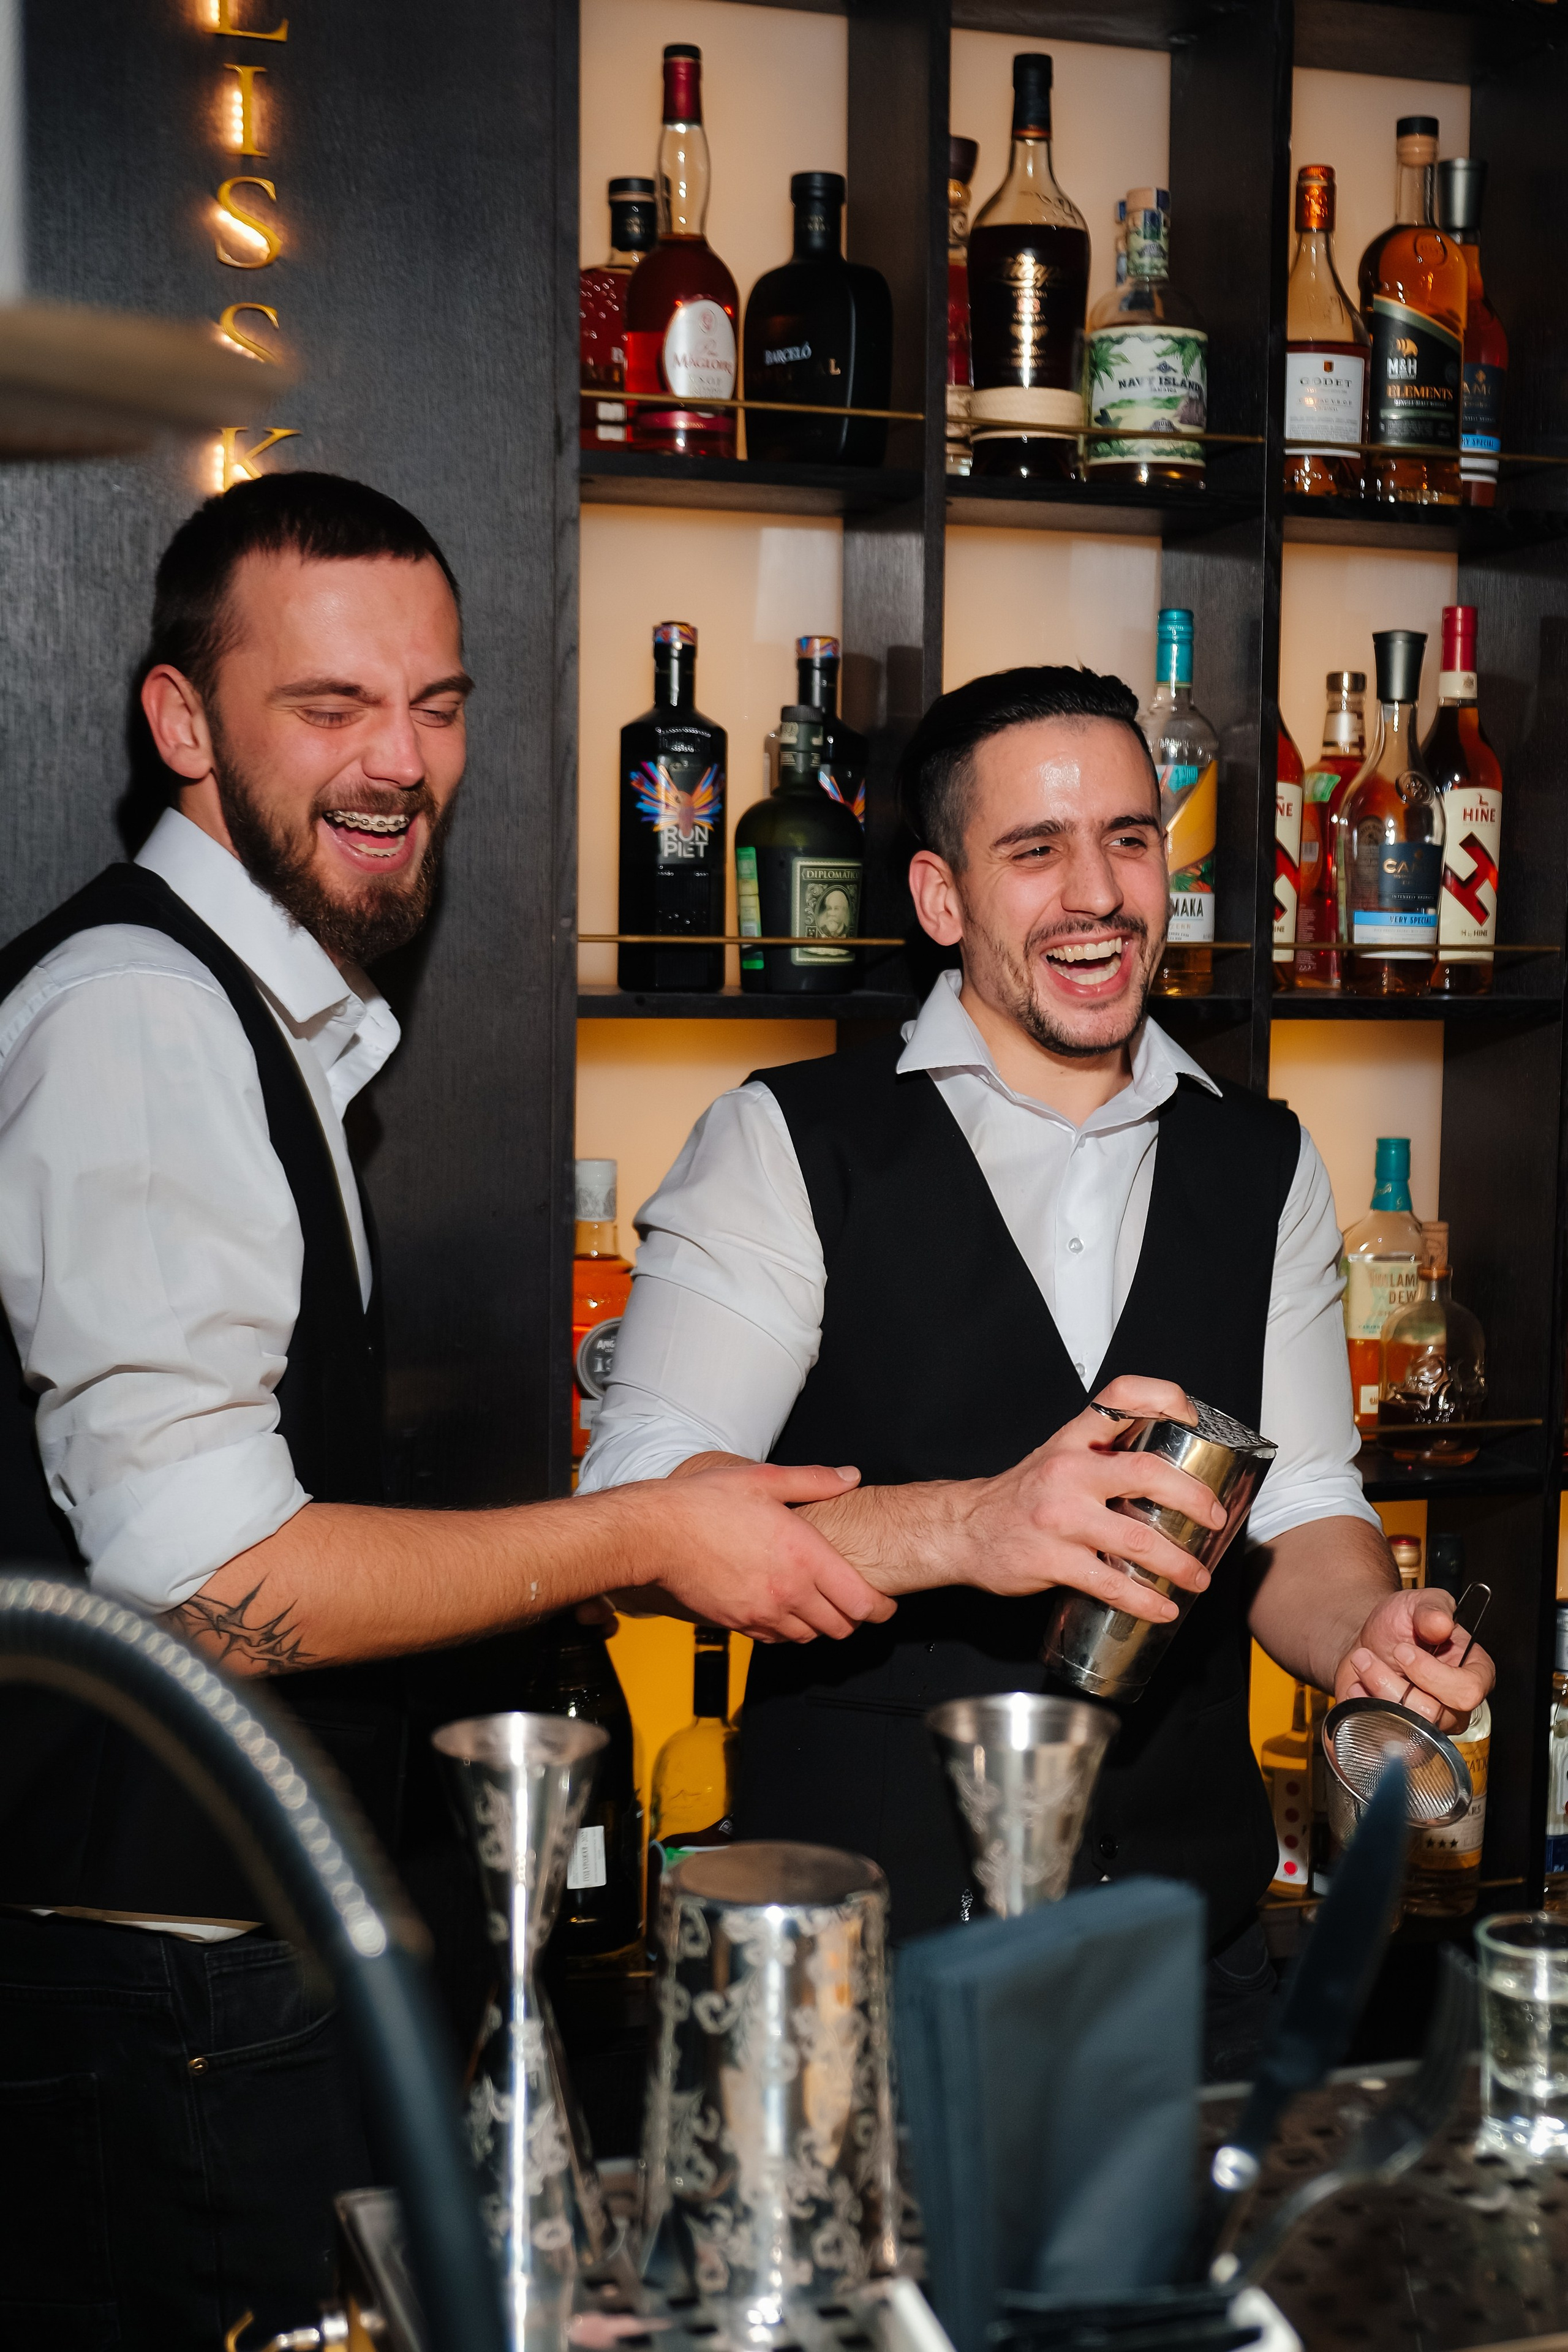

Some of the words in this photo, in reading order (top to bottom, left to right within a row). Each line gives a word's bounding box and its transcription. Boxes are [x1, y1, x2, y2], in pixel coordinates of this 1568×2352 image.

[1387, 357, 1417, 375] M&H
[1118, 376, 1156, 390] NAVY
[1158, 375, 1200, 391] ISLAND
[1300, 377, 1352, 388] GODET
[1387, 384, 1453, 401] ELEMENTS
[1472, 439, 1494, 448] SPECIAL
[1463, 808, 1496, 822] HINE
[663, 825, 709, 842] RON
[663, 841, 709, 858] PIET
[1390, 916, 1408, 924] VERY
[1410, 916, 1431, 925] SPECIAL
